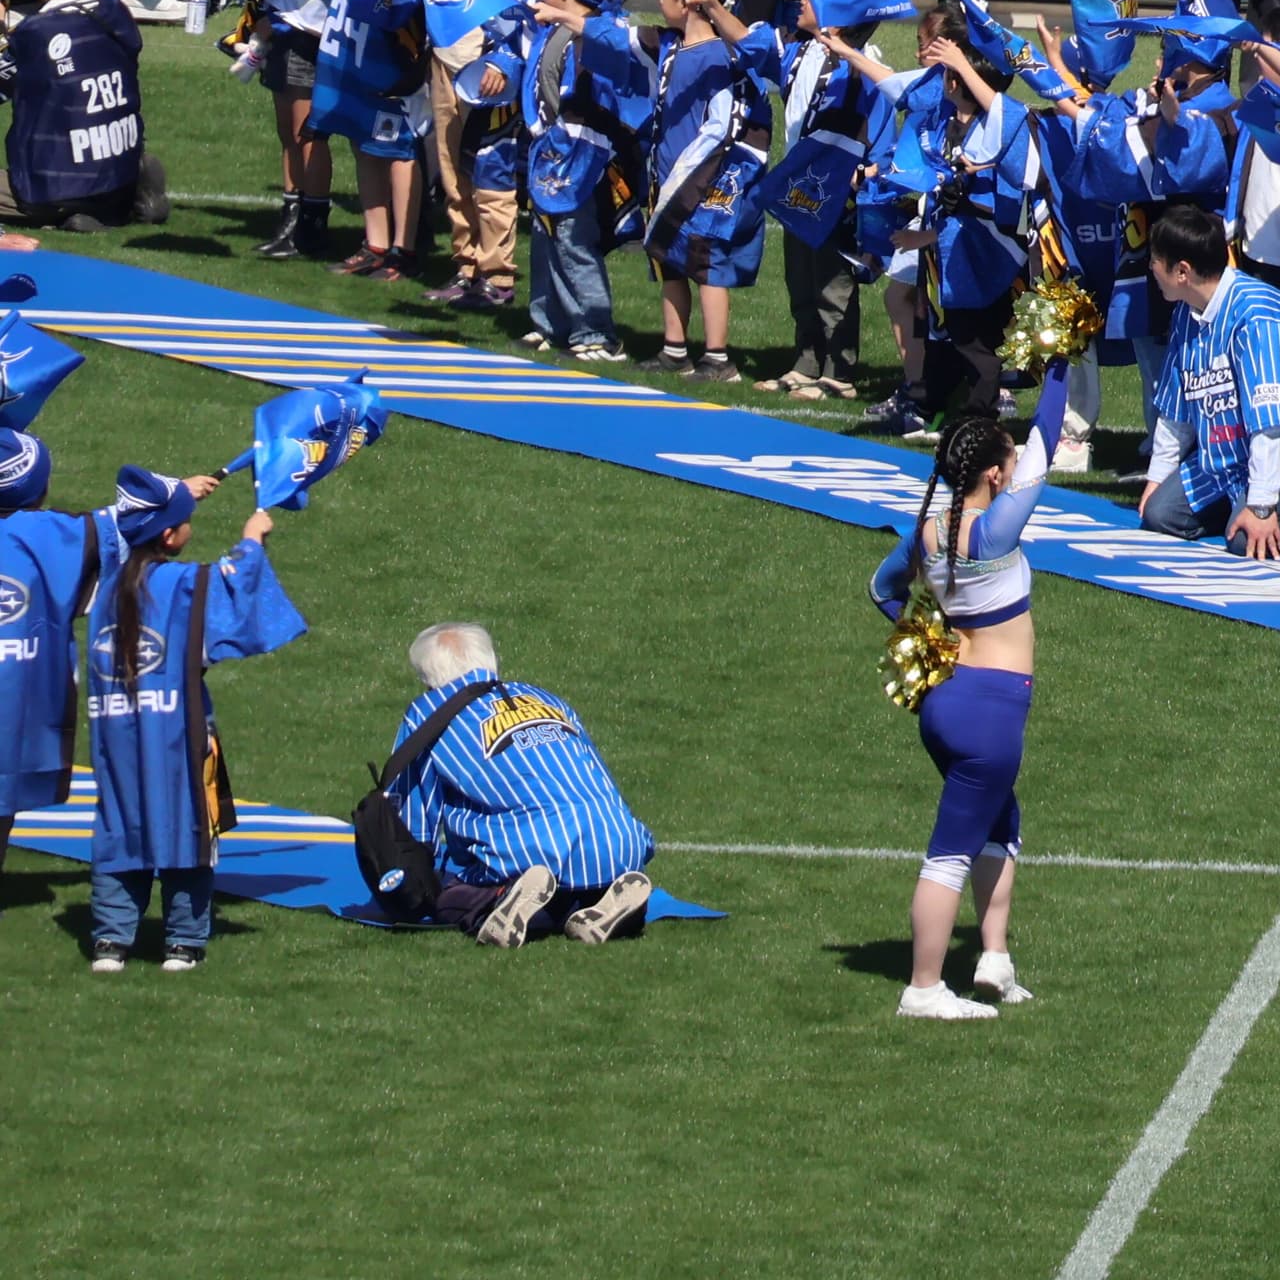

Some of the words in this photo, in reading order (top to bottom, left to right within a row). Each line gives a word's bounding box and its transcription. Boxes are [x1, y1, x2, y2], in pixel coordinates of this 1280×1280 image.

[56, 62, 75, 75] ONE
[81, 70, 129, 114] 282
[70, 113, 138, 164] PHOTO
[512, 723, 568, 750] CAST
